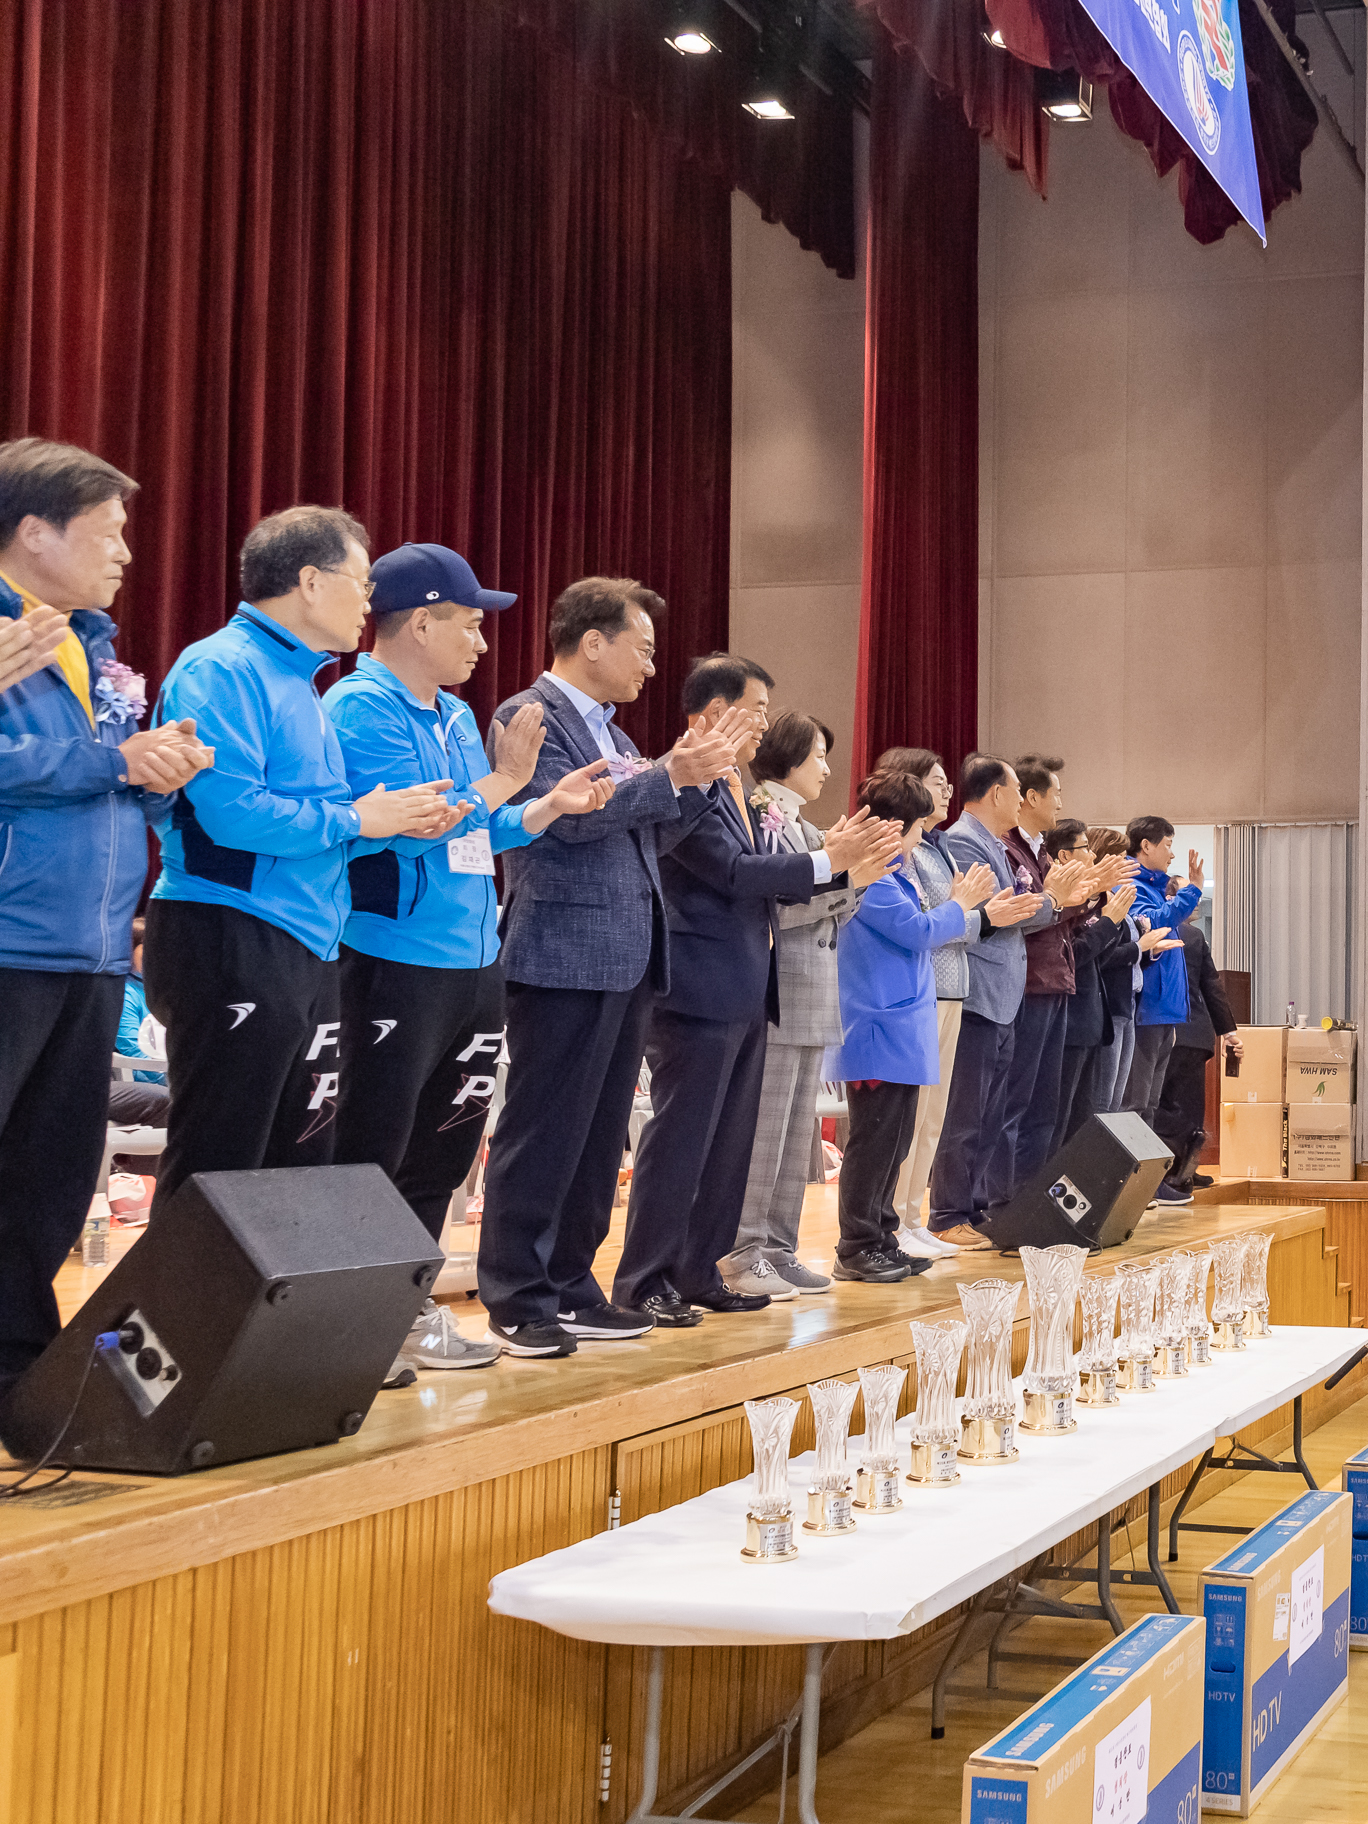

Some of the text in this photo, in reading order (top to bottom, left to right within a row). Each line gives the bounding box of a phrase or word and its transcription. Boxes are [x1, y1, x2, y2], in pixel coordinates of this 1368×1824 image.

[1300, 1066, 1338, 1076] SAM HWA
[1208, 1593, 1242, 1602] SAMSUNG
[1005, 1722, 1055, 1757] SAMSUNG
[1045, 1745, 1087, 1799] SAMSUNG
[1205, 1770, 1228, 1790] 80
[976, 1789, 1022, 1802] SAMSUNG
